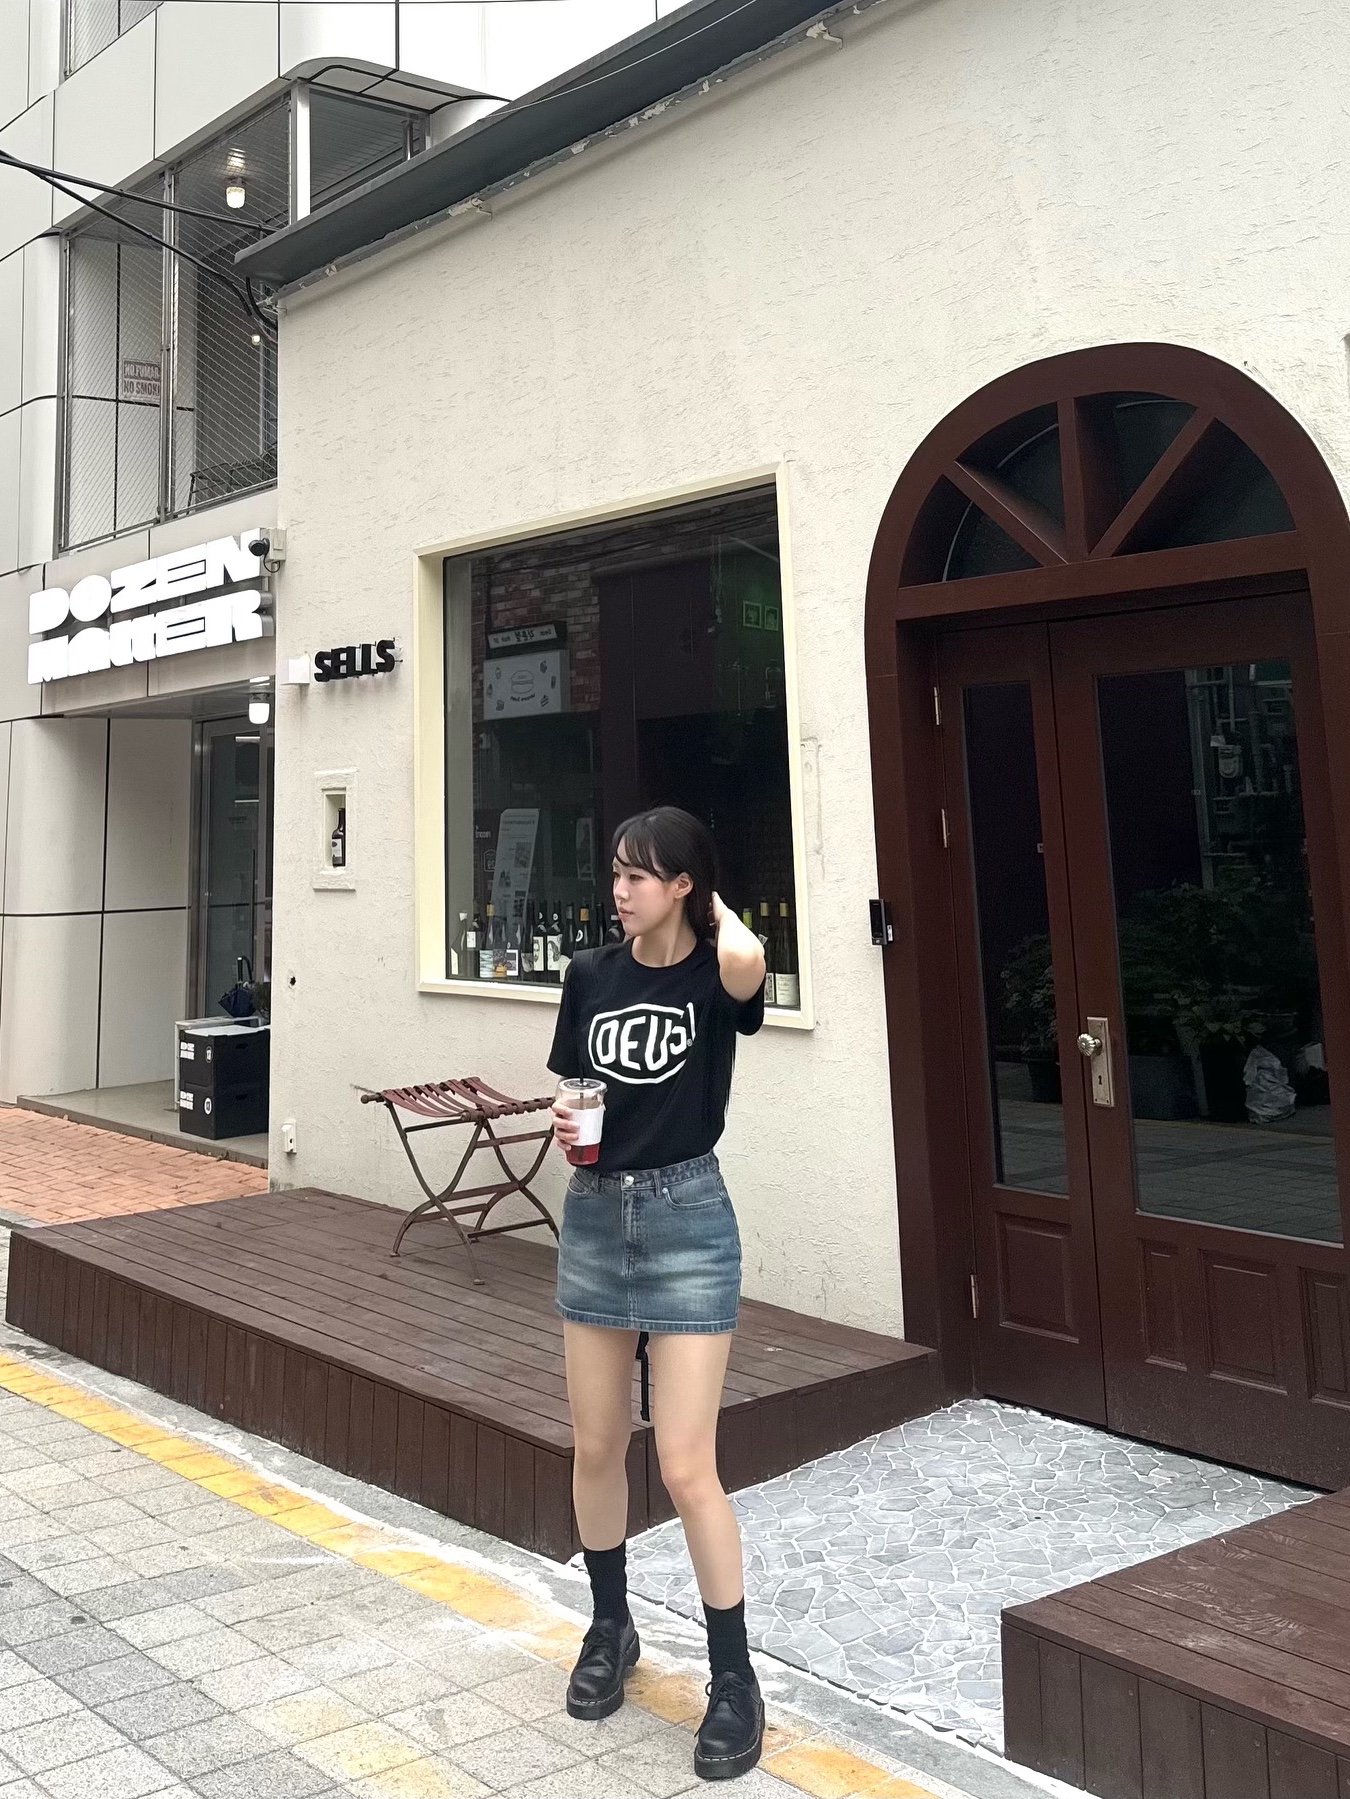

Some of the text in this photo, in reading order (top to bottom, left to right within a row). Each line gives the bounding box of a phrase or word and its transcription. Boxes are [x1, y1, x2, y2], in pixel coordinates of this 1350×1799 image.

[123, 380, 135, 394] NO
[29, 528, 262, 635] DOZEN
[314, 639, 395, 682] SELLS
[596, 1014, 688, 1071] DEUS
